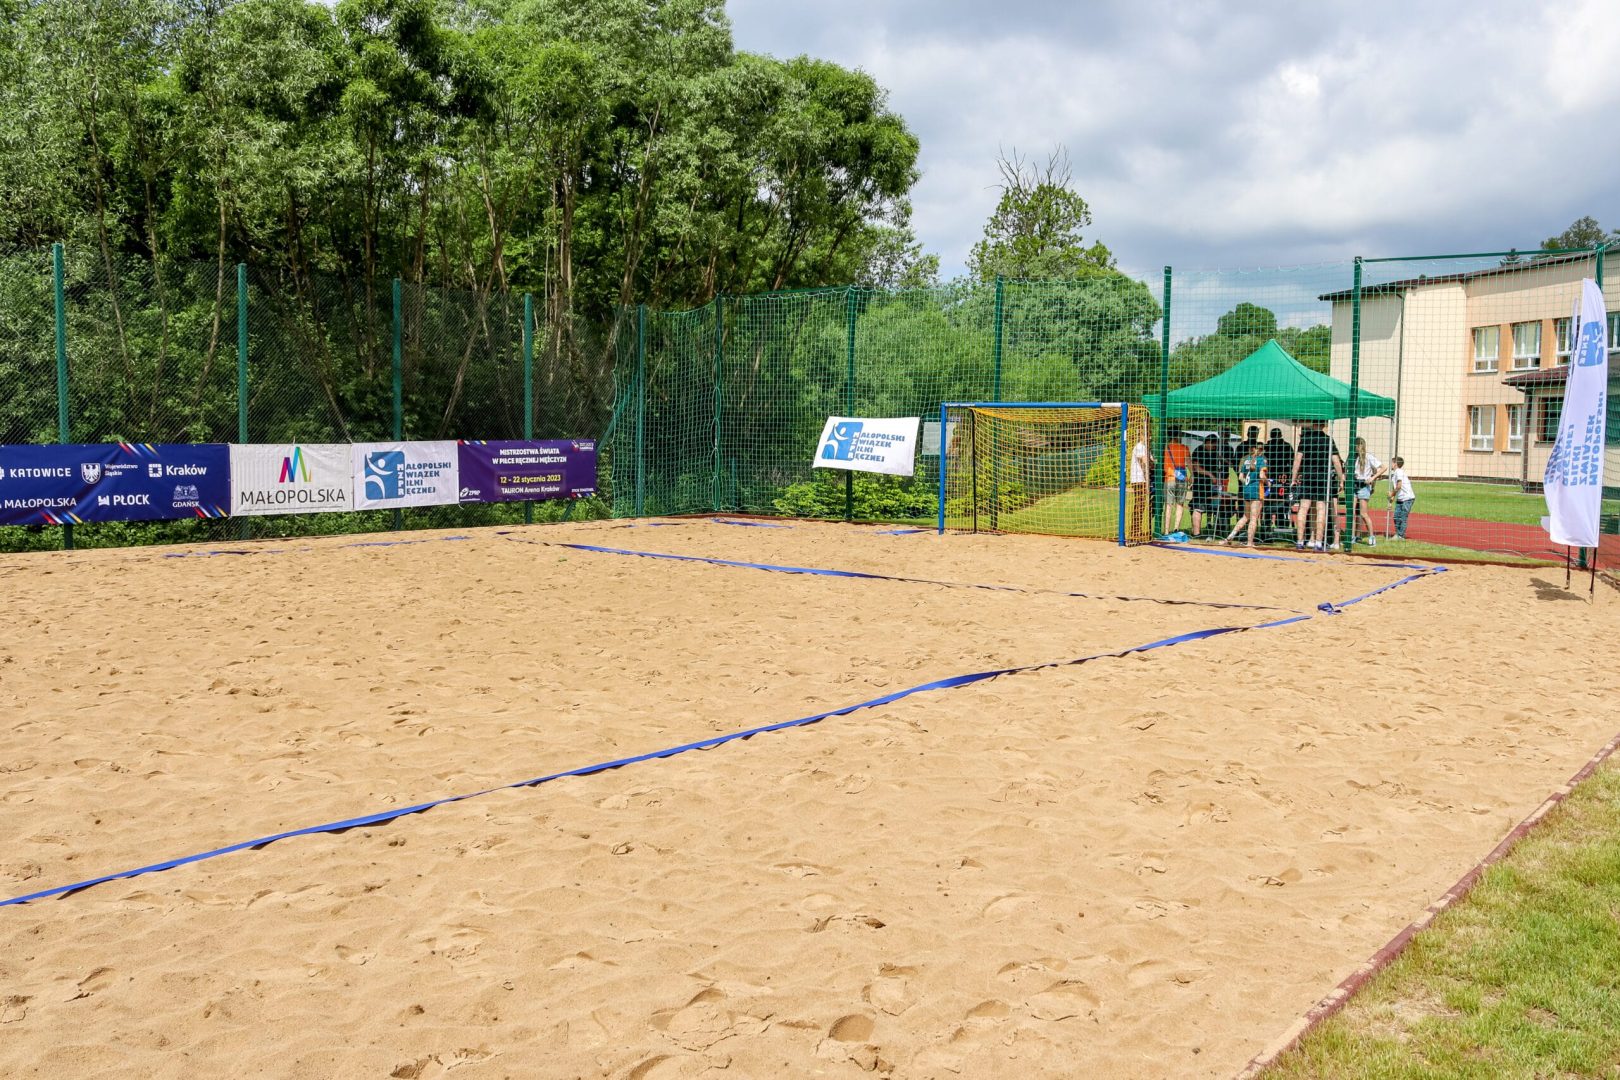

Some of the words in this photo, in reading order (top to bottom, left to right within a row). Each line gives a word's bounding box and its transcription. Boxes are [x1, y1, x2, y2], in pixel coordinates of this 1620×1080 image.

[10, 467, 72, 478] KATOWICE
[166, 464, 207, 476] Kraków
[521, 475, 546, 484] stycznia
[547, 474, 561, 482] 2023
[501, 486, 524, 494] TAURON
[113, 494, 150, 506] PŁOCK
[241, 488, 346, 505] MAŁOPOLSKA
[4, 497, 77, 509] MAŁOPOLSKA
[172, 500, 200, 508] GDAŃSK
